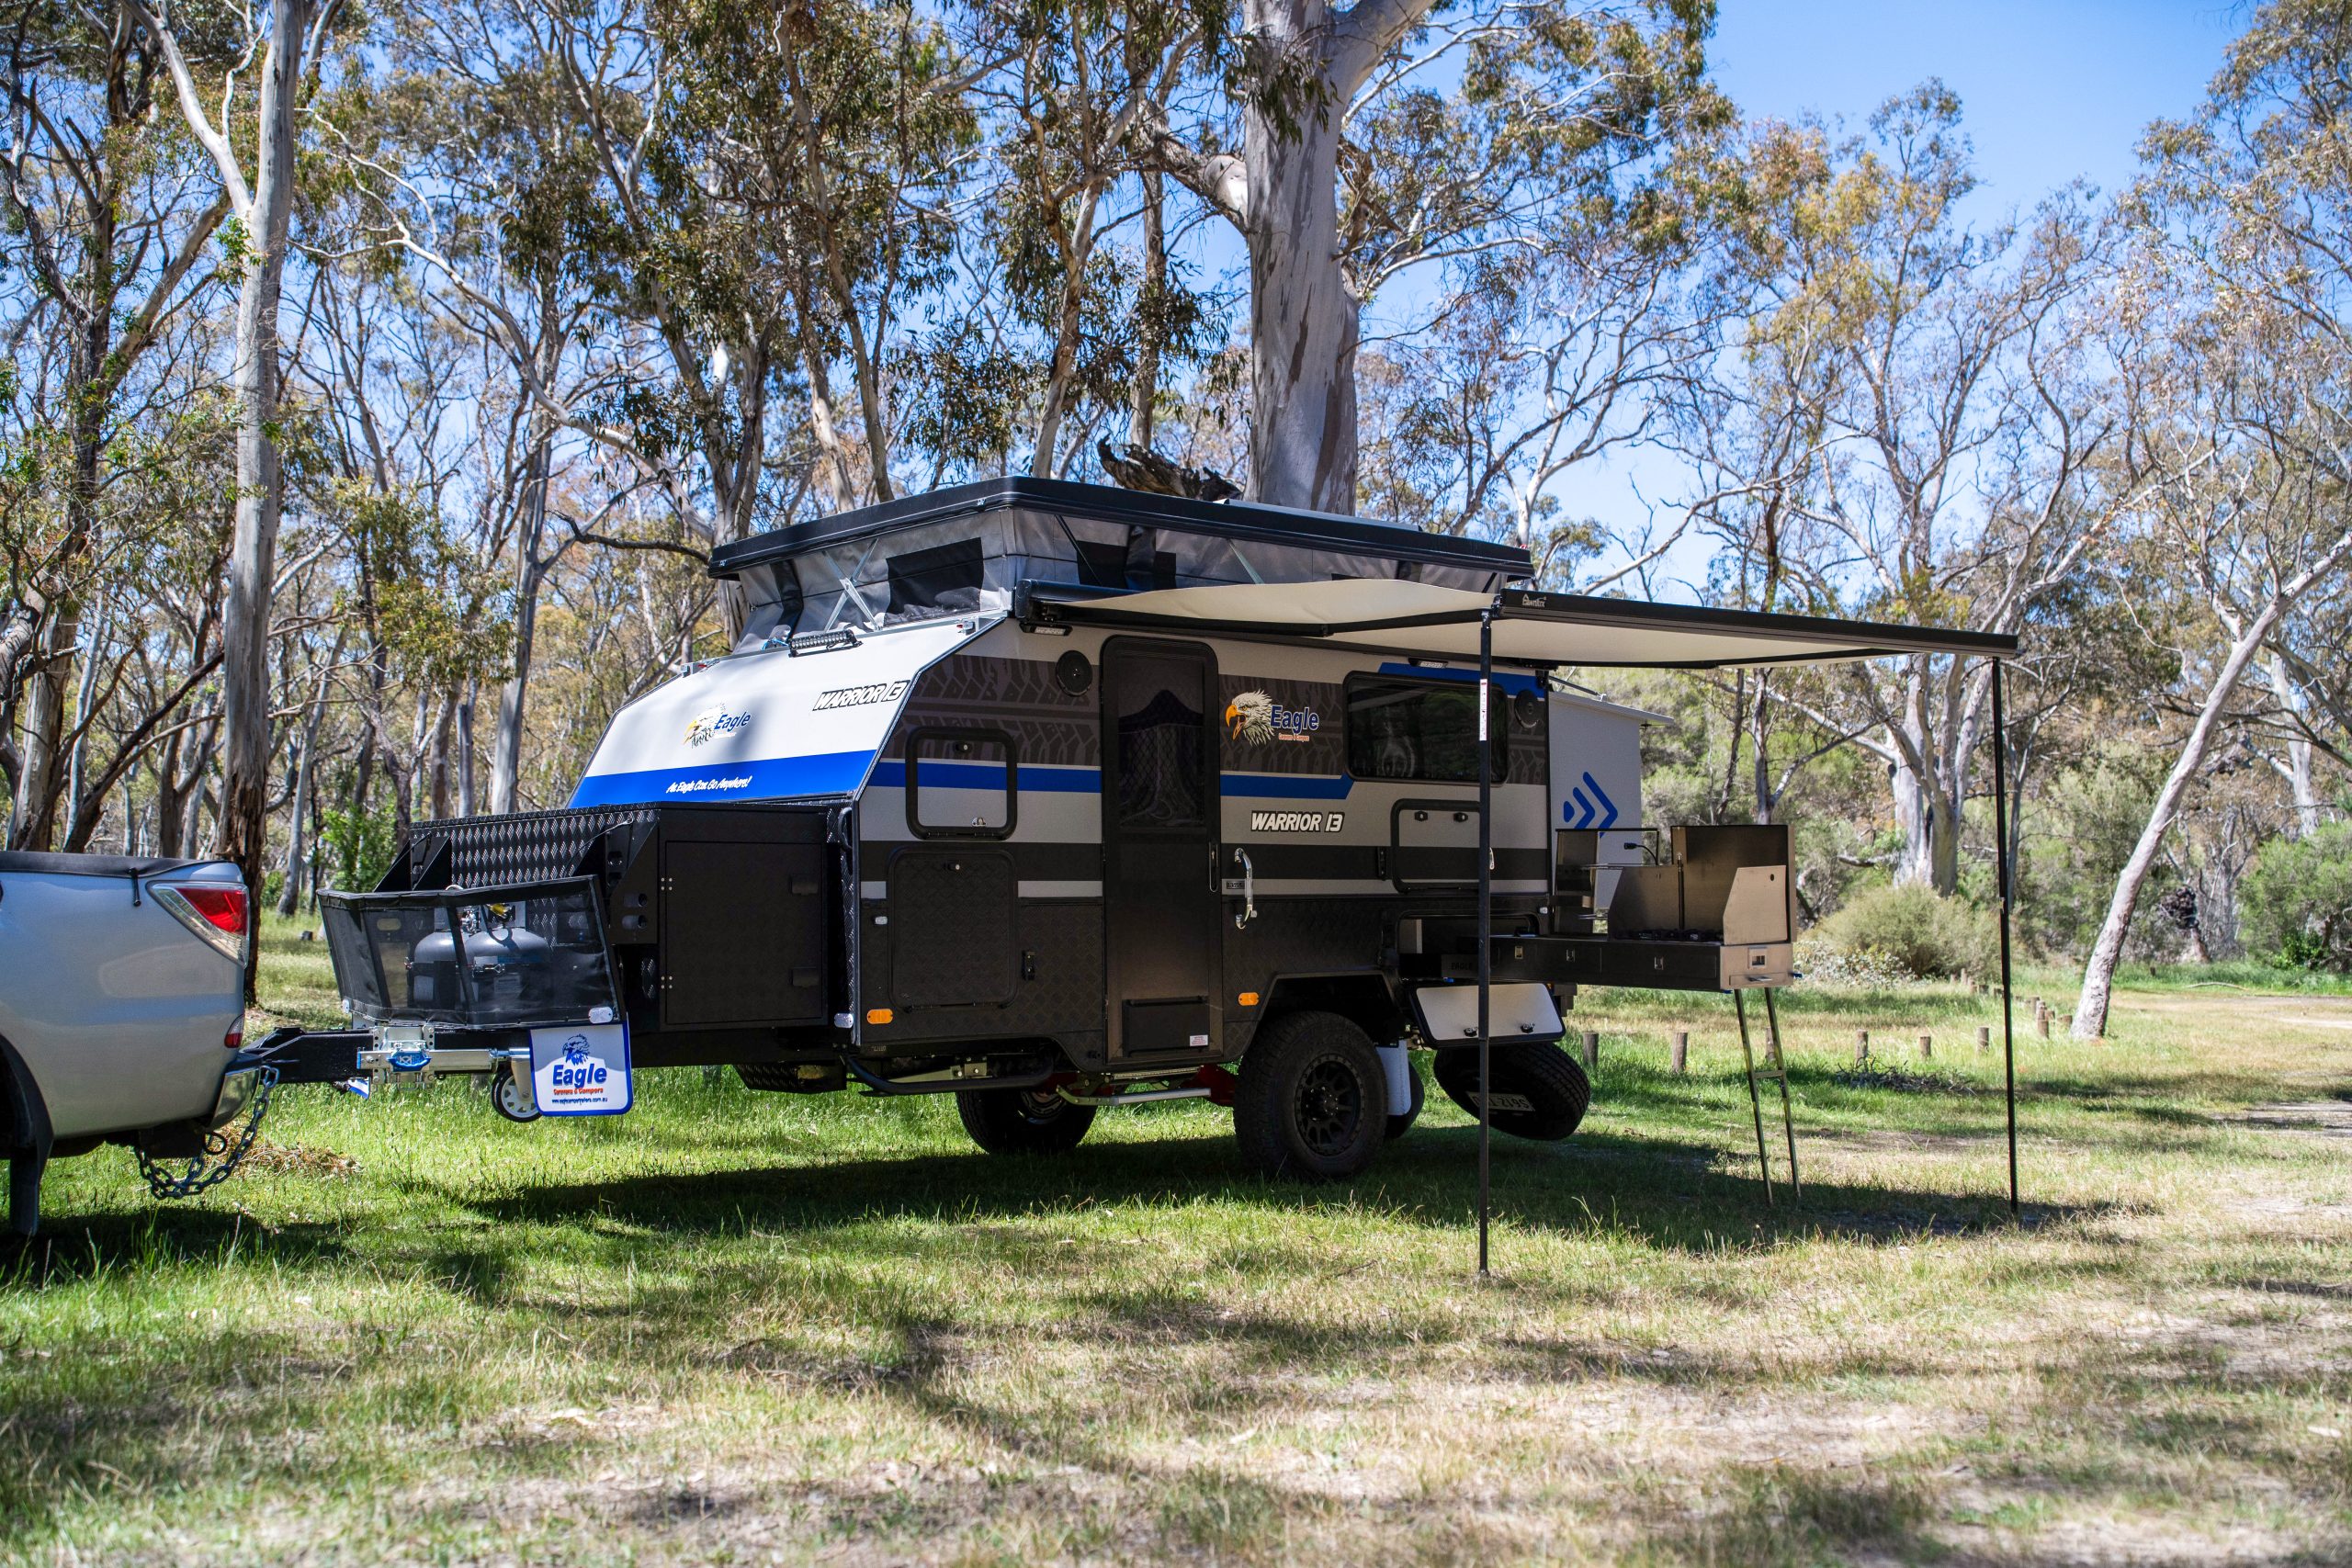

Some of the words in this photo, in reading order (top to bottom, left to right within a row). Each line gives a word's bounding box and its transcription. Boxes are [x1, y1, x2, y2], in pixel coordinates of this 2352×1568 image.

[812, 683, 888, 712] WARRIOR
[881, 680, 910, 703] 13
[714, 711, 752, 732] Eagle
[1271, 705, 1319, 735] Eagle
[676, 780, 695, 794] Eagle
[694, 779, 708, 791] Can
[707, 778, 718, 790] Go
[717, 775, 753, 791] Anywhere!
[1250, 809, 1323, 833] WARRIOR
[1324, 811, 1346, 833] 13
[552, 1063, 607, 1089] Eagle
